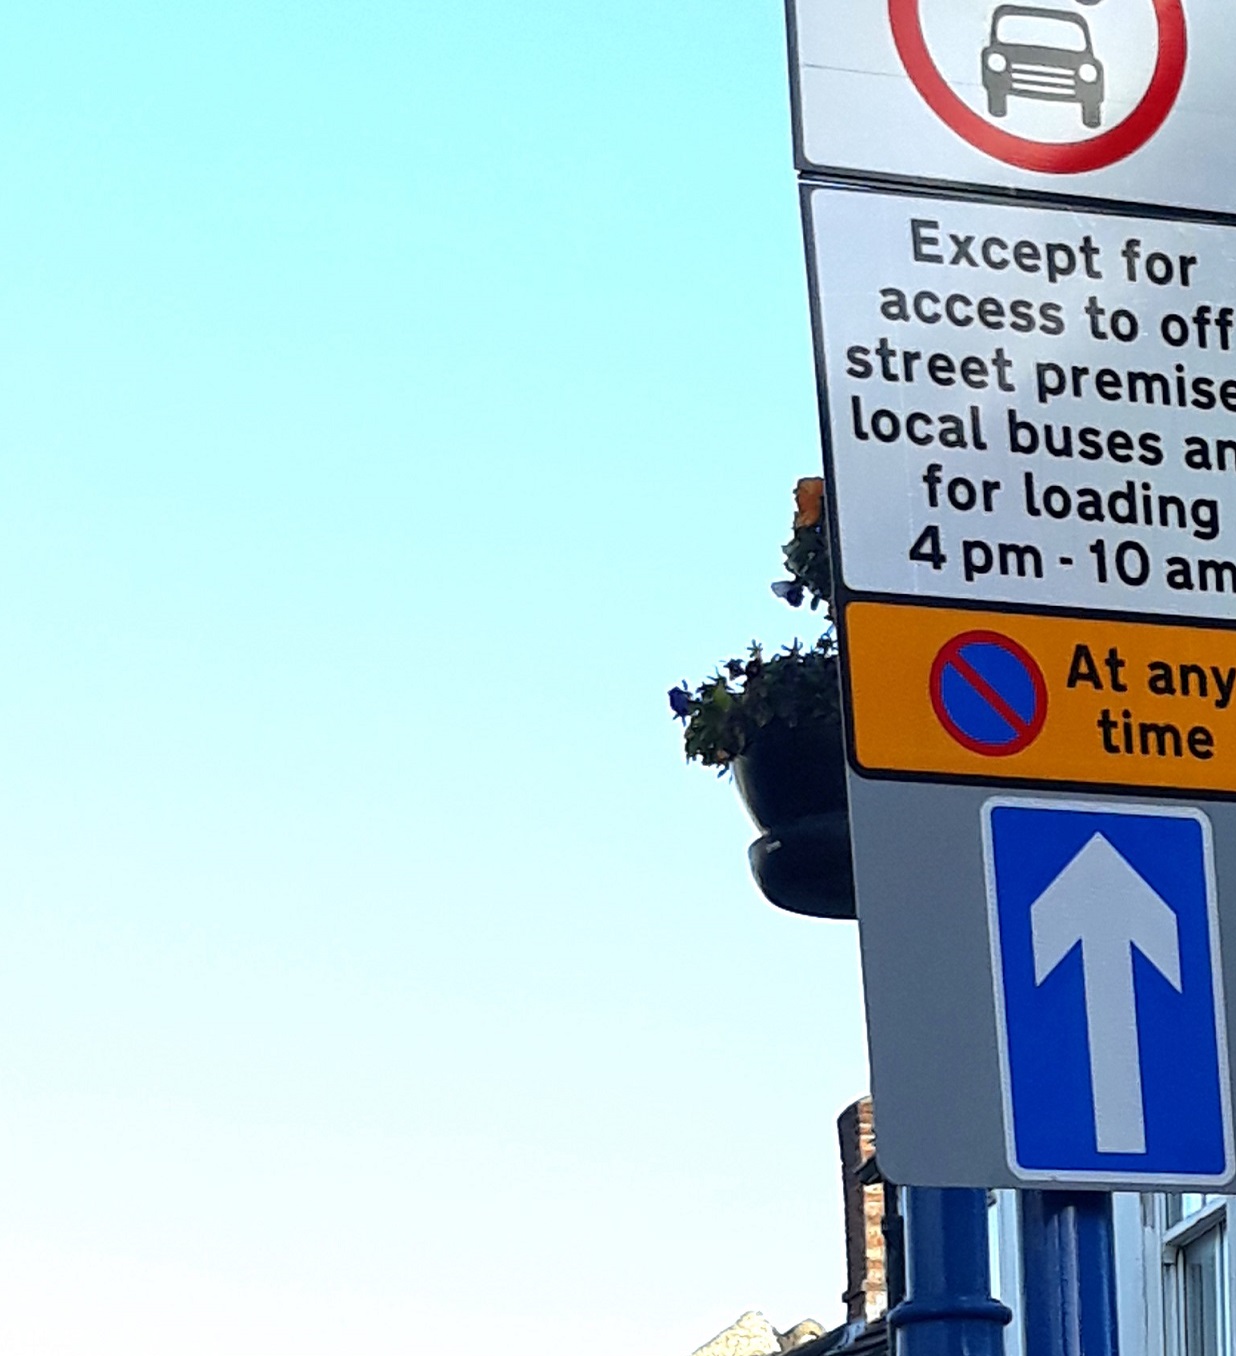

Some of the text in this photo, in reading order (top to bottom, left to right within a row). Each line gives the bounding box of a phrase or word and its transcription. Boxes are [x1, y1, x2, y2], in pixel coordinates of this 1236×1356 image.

[910, 218, 1197, 287] Except for
[880, 287, 1235, 351] access to off
[846, 338, 1015, 393] street
[851, 396, 987, 451] local
[1008, 409, 1164, 466] buses
[923, 464, 1220, 540] for loading
[909, 525, 947, 571] 4
[963, 538, 1044, 582] pm
[1090, 539, 1149, 588] 10
[1066, 644, 1128, 693] At
[1097, 709, 1215, 760] time
